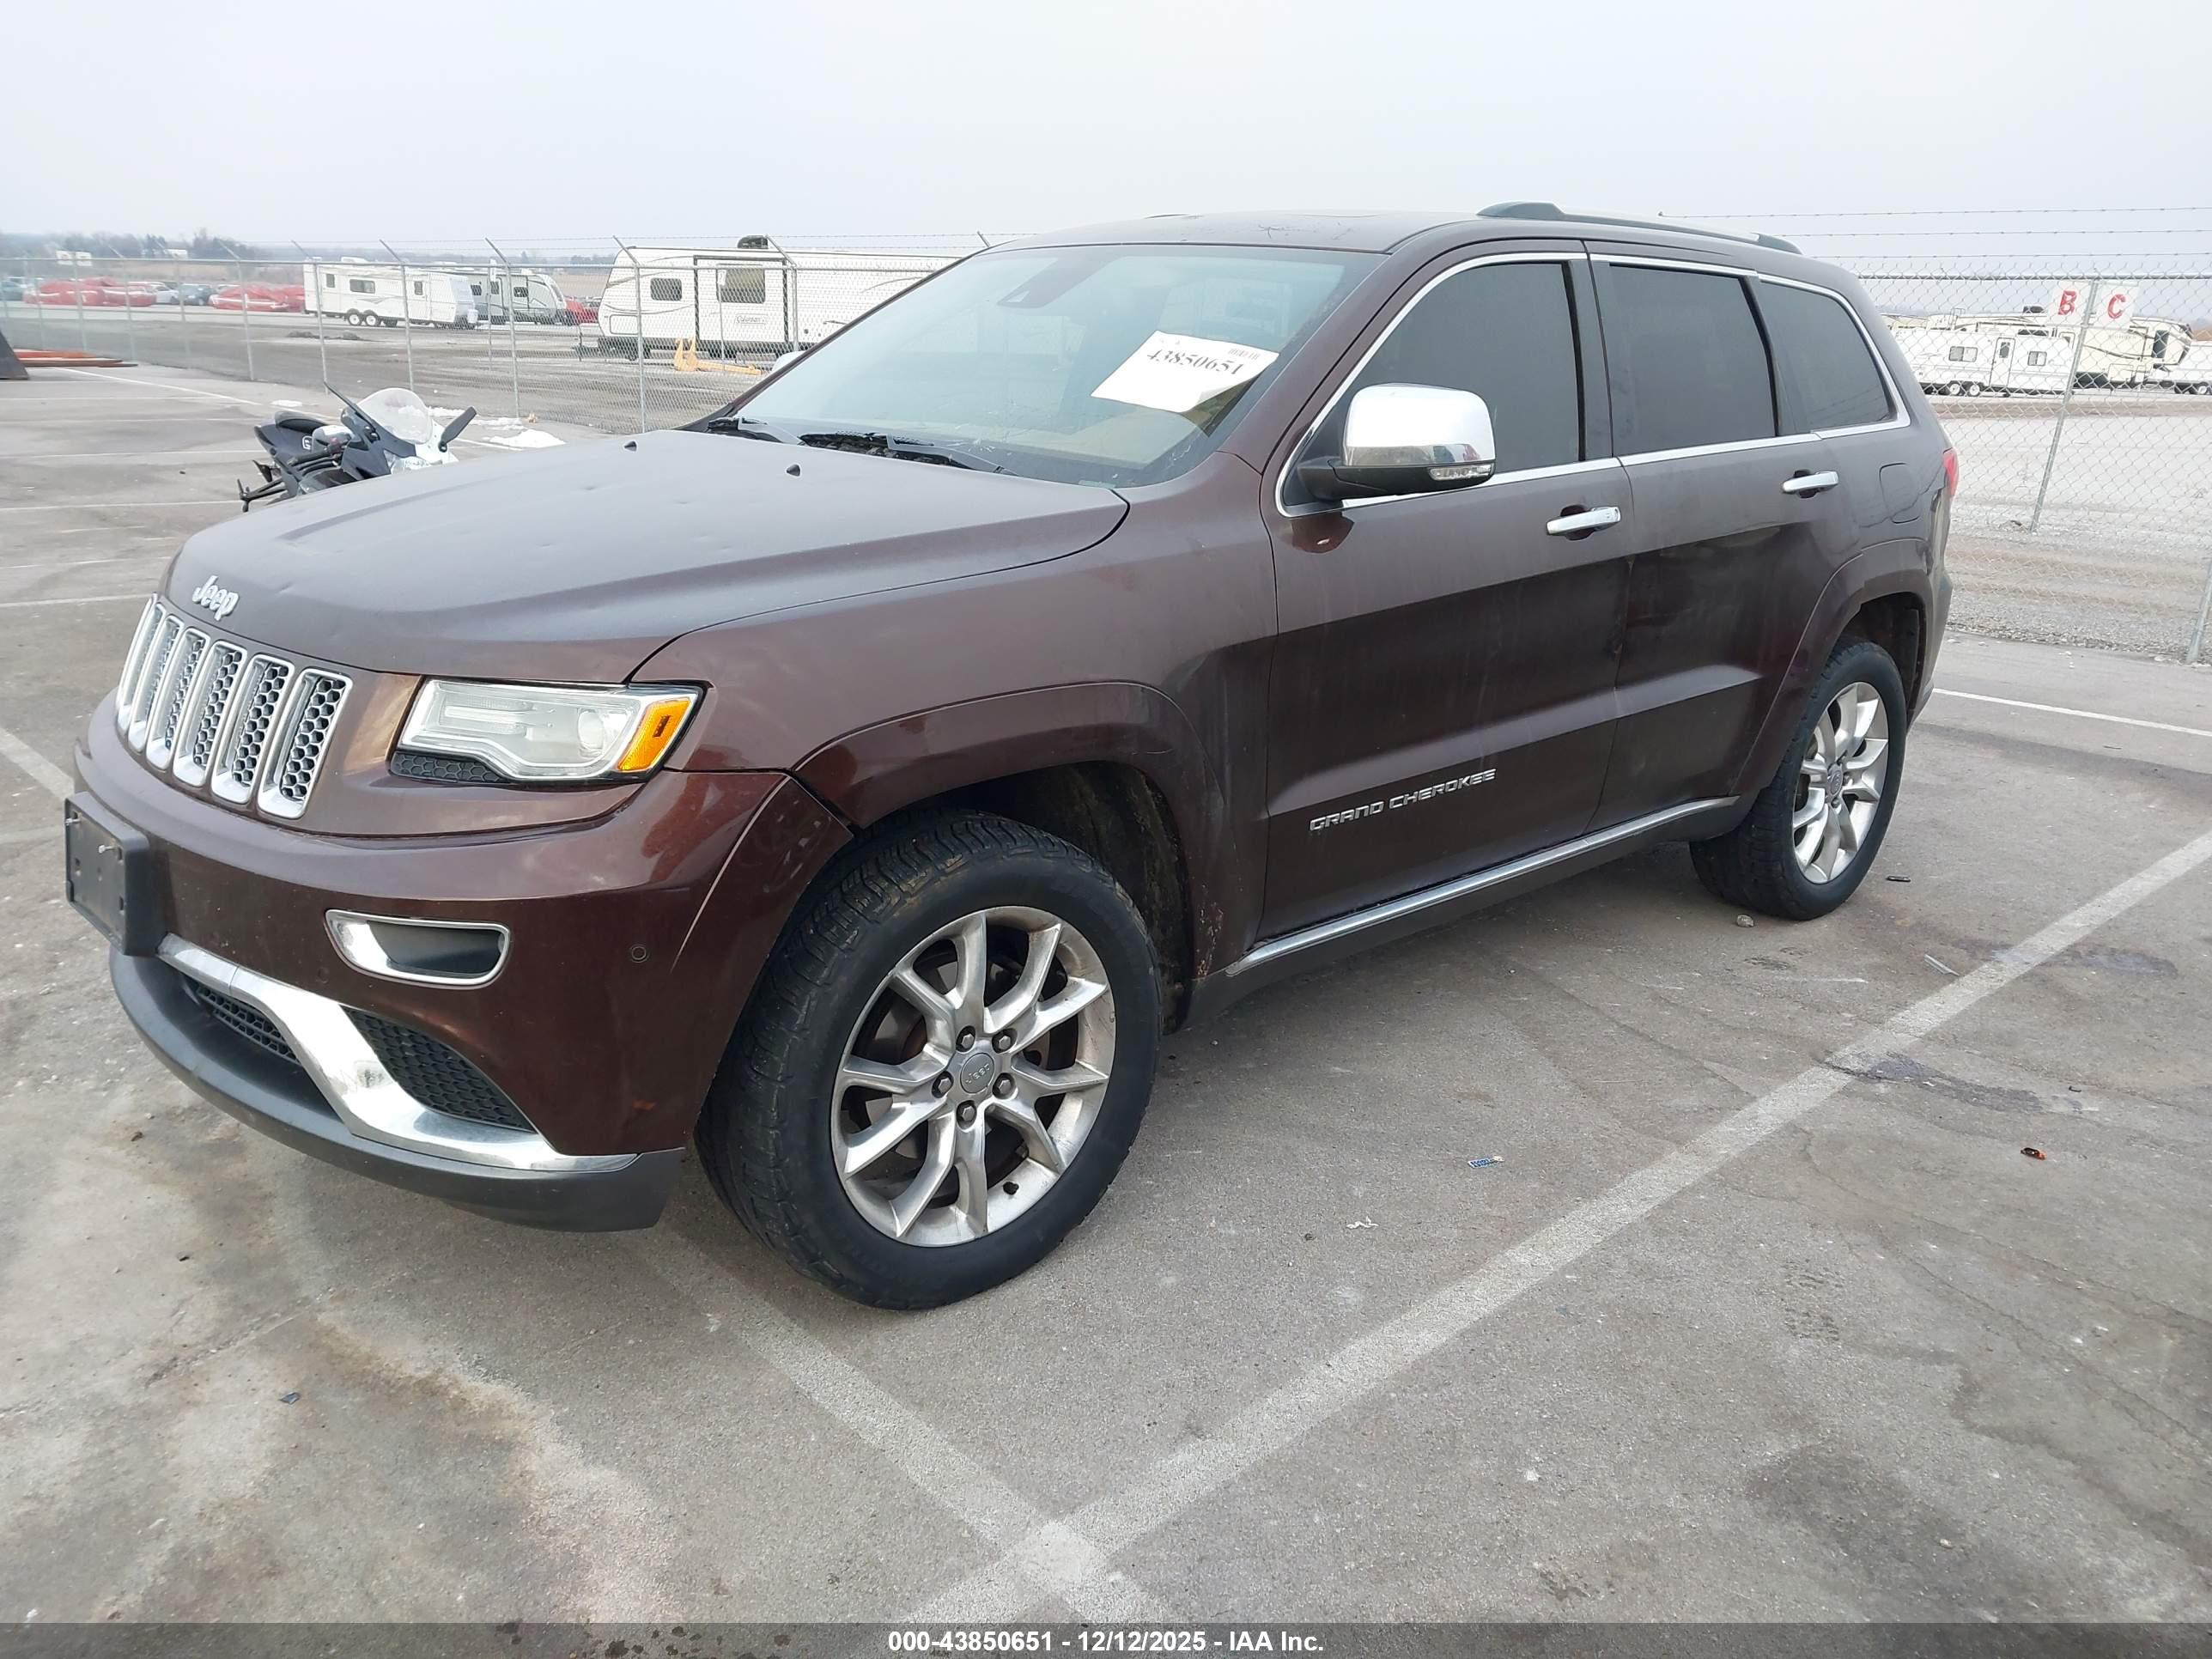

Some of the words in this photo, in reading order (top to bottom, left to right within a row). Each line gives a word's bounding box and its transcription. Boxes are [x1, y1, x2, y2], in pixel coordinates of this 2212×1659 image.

[2058, 289, 2077, 315] B
[2108, 294, 2126, 319] C
[1147, 349, 1244, 374] 43850651
[192, 575, 240, 621] Jeep
[1310, 800, 1385, 831] GRAND
[1389, 769, 1497, 810] CHEROKEE
